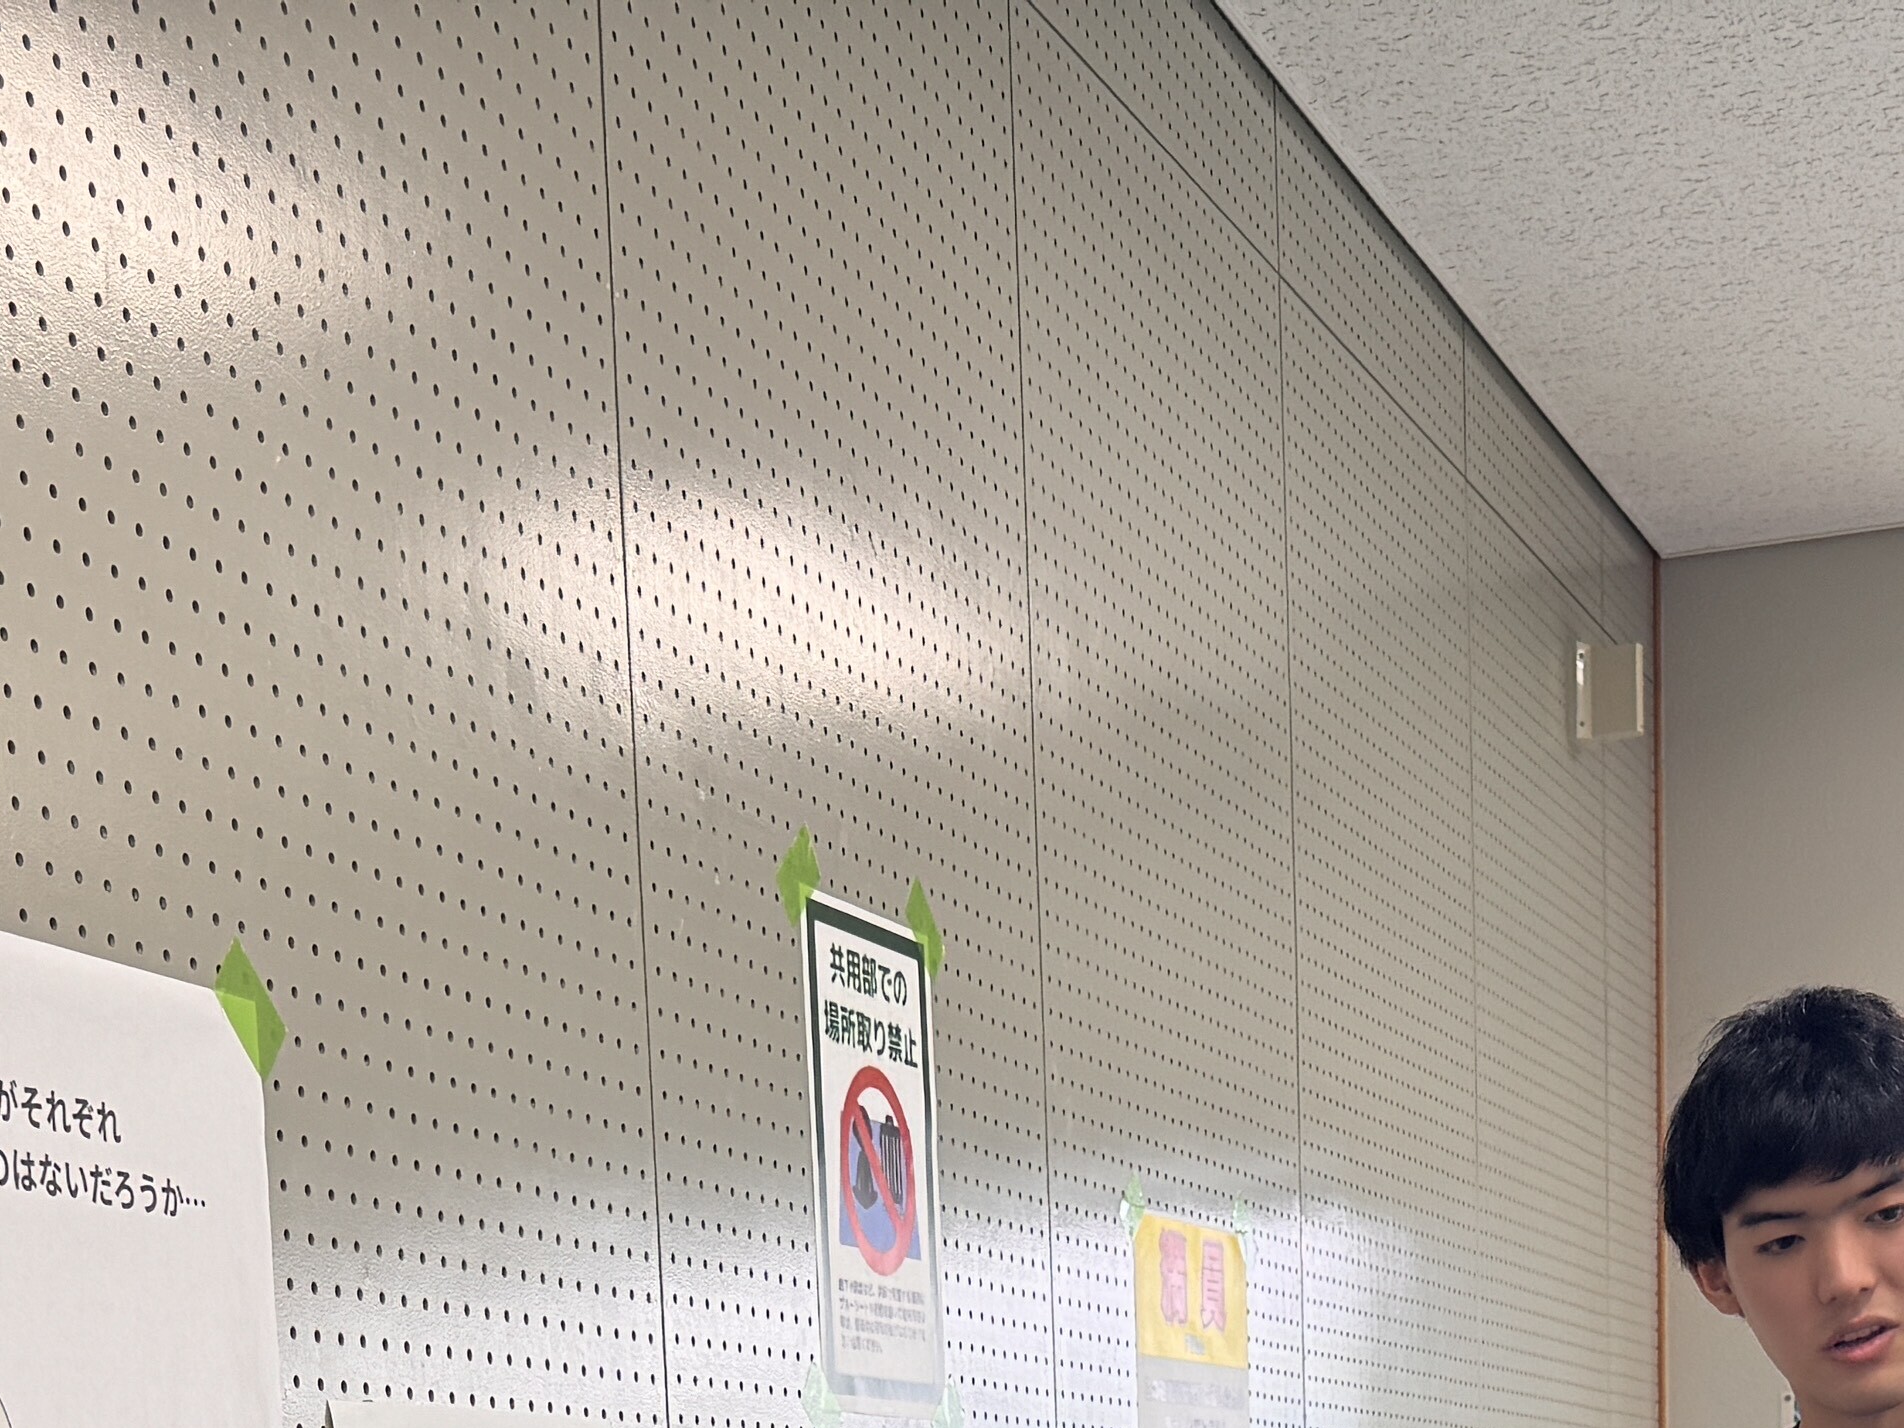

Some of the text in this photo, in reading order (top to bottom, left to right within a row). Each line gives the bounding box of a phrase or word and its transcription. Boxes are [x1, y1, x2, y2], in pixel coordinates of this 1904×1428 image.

[830, 942, 907, 1006] 共用部での
[824, 999, 918, 1068] 場所取り禁止
